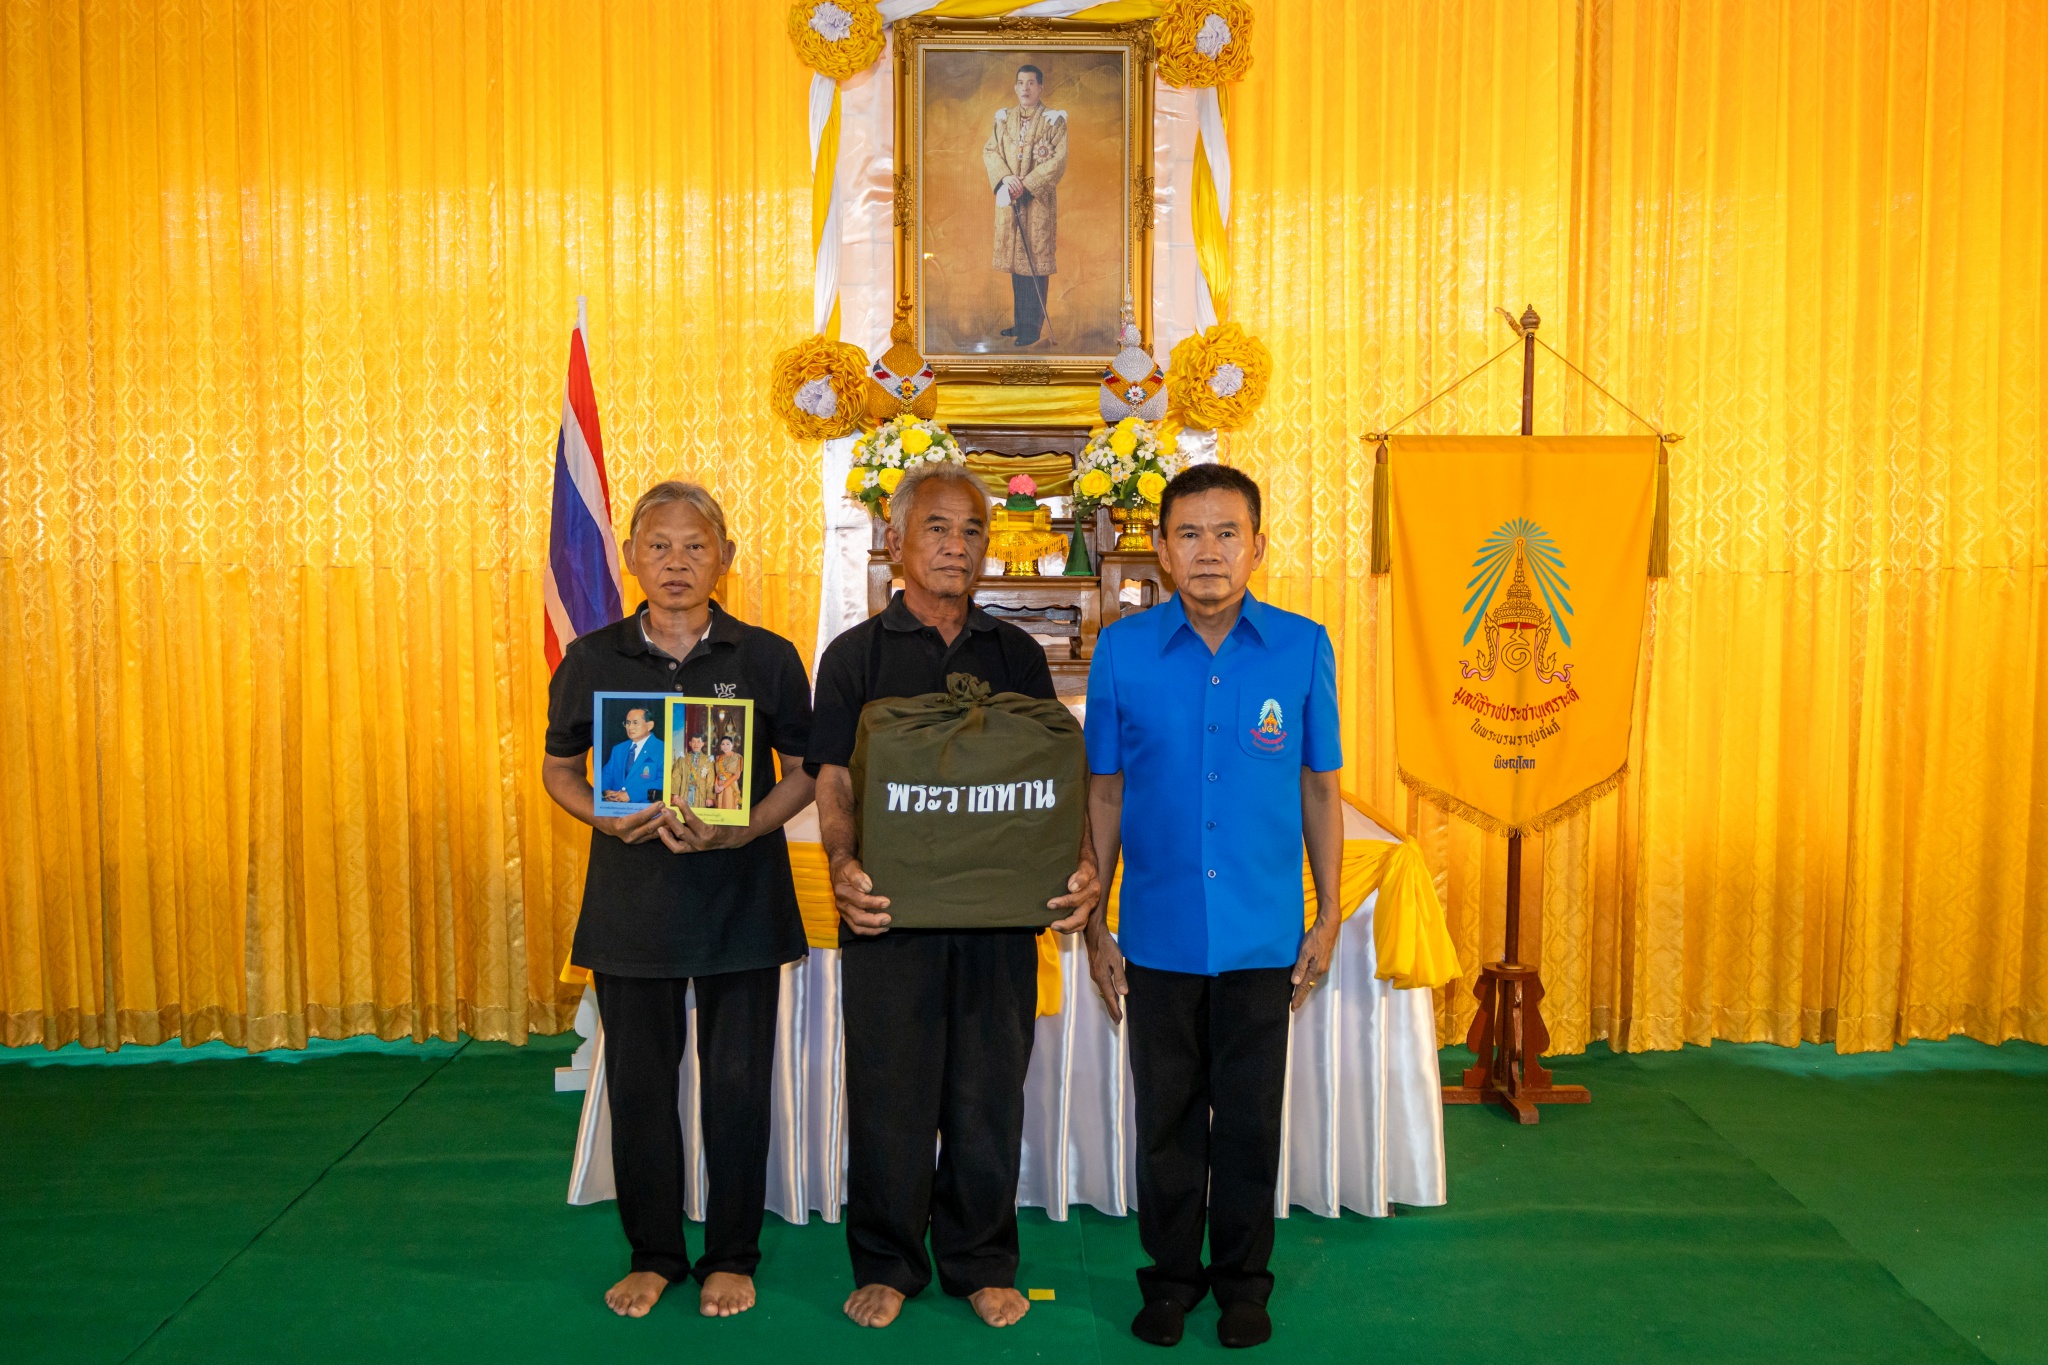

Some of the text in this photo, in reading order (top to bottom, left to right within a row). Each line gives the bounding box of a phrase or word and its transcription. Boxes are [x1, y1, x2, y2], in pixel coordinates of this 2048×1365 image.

[1493, 754, 1536, 774] พิษณุโลก
[886, 779, 1056, 813] พระราชทาน
